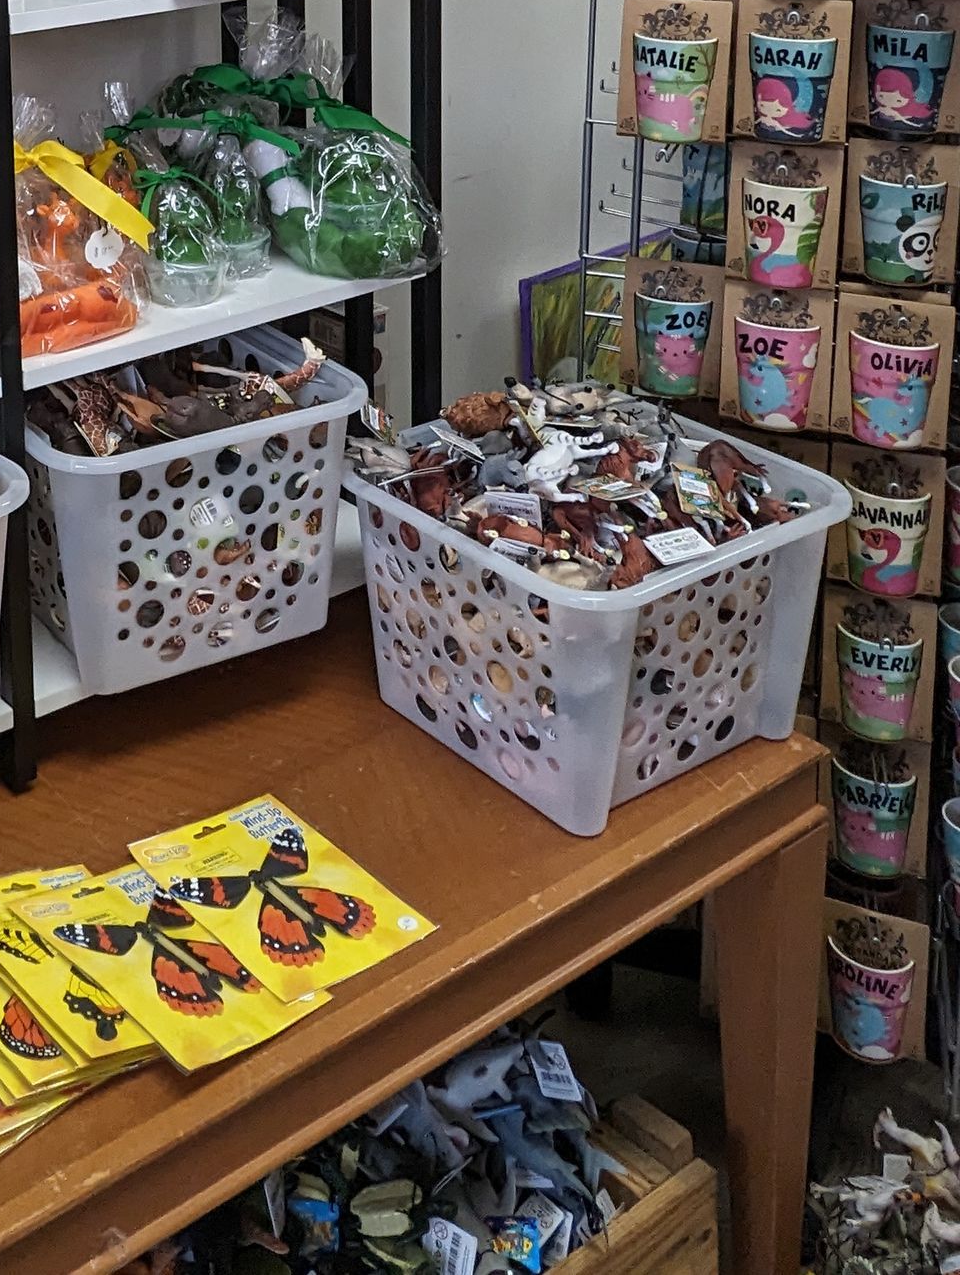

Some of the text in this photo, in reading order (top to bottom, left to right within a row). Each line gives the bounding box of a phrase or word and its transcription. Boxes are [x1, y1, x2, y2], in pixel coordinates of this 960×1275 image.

[754, 45, 824, 71] SARAH
[745, 194, 797, 223] NORA
[738, 333, 789, 361] ZOE
[240, 808, 281, 828] Wind-Up
[248, 816, 294, 839] Butterfly
